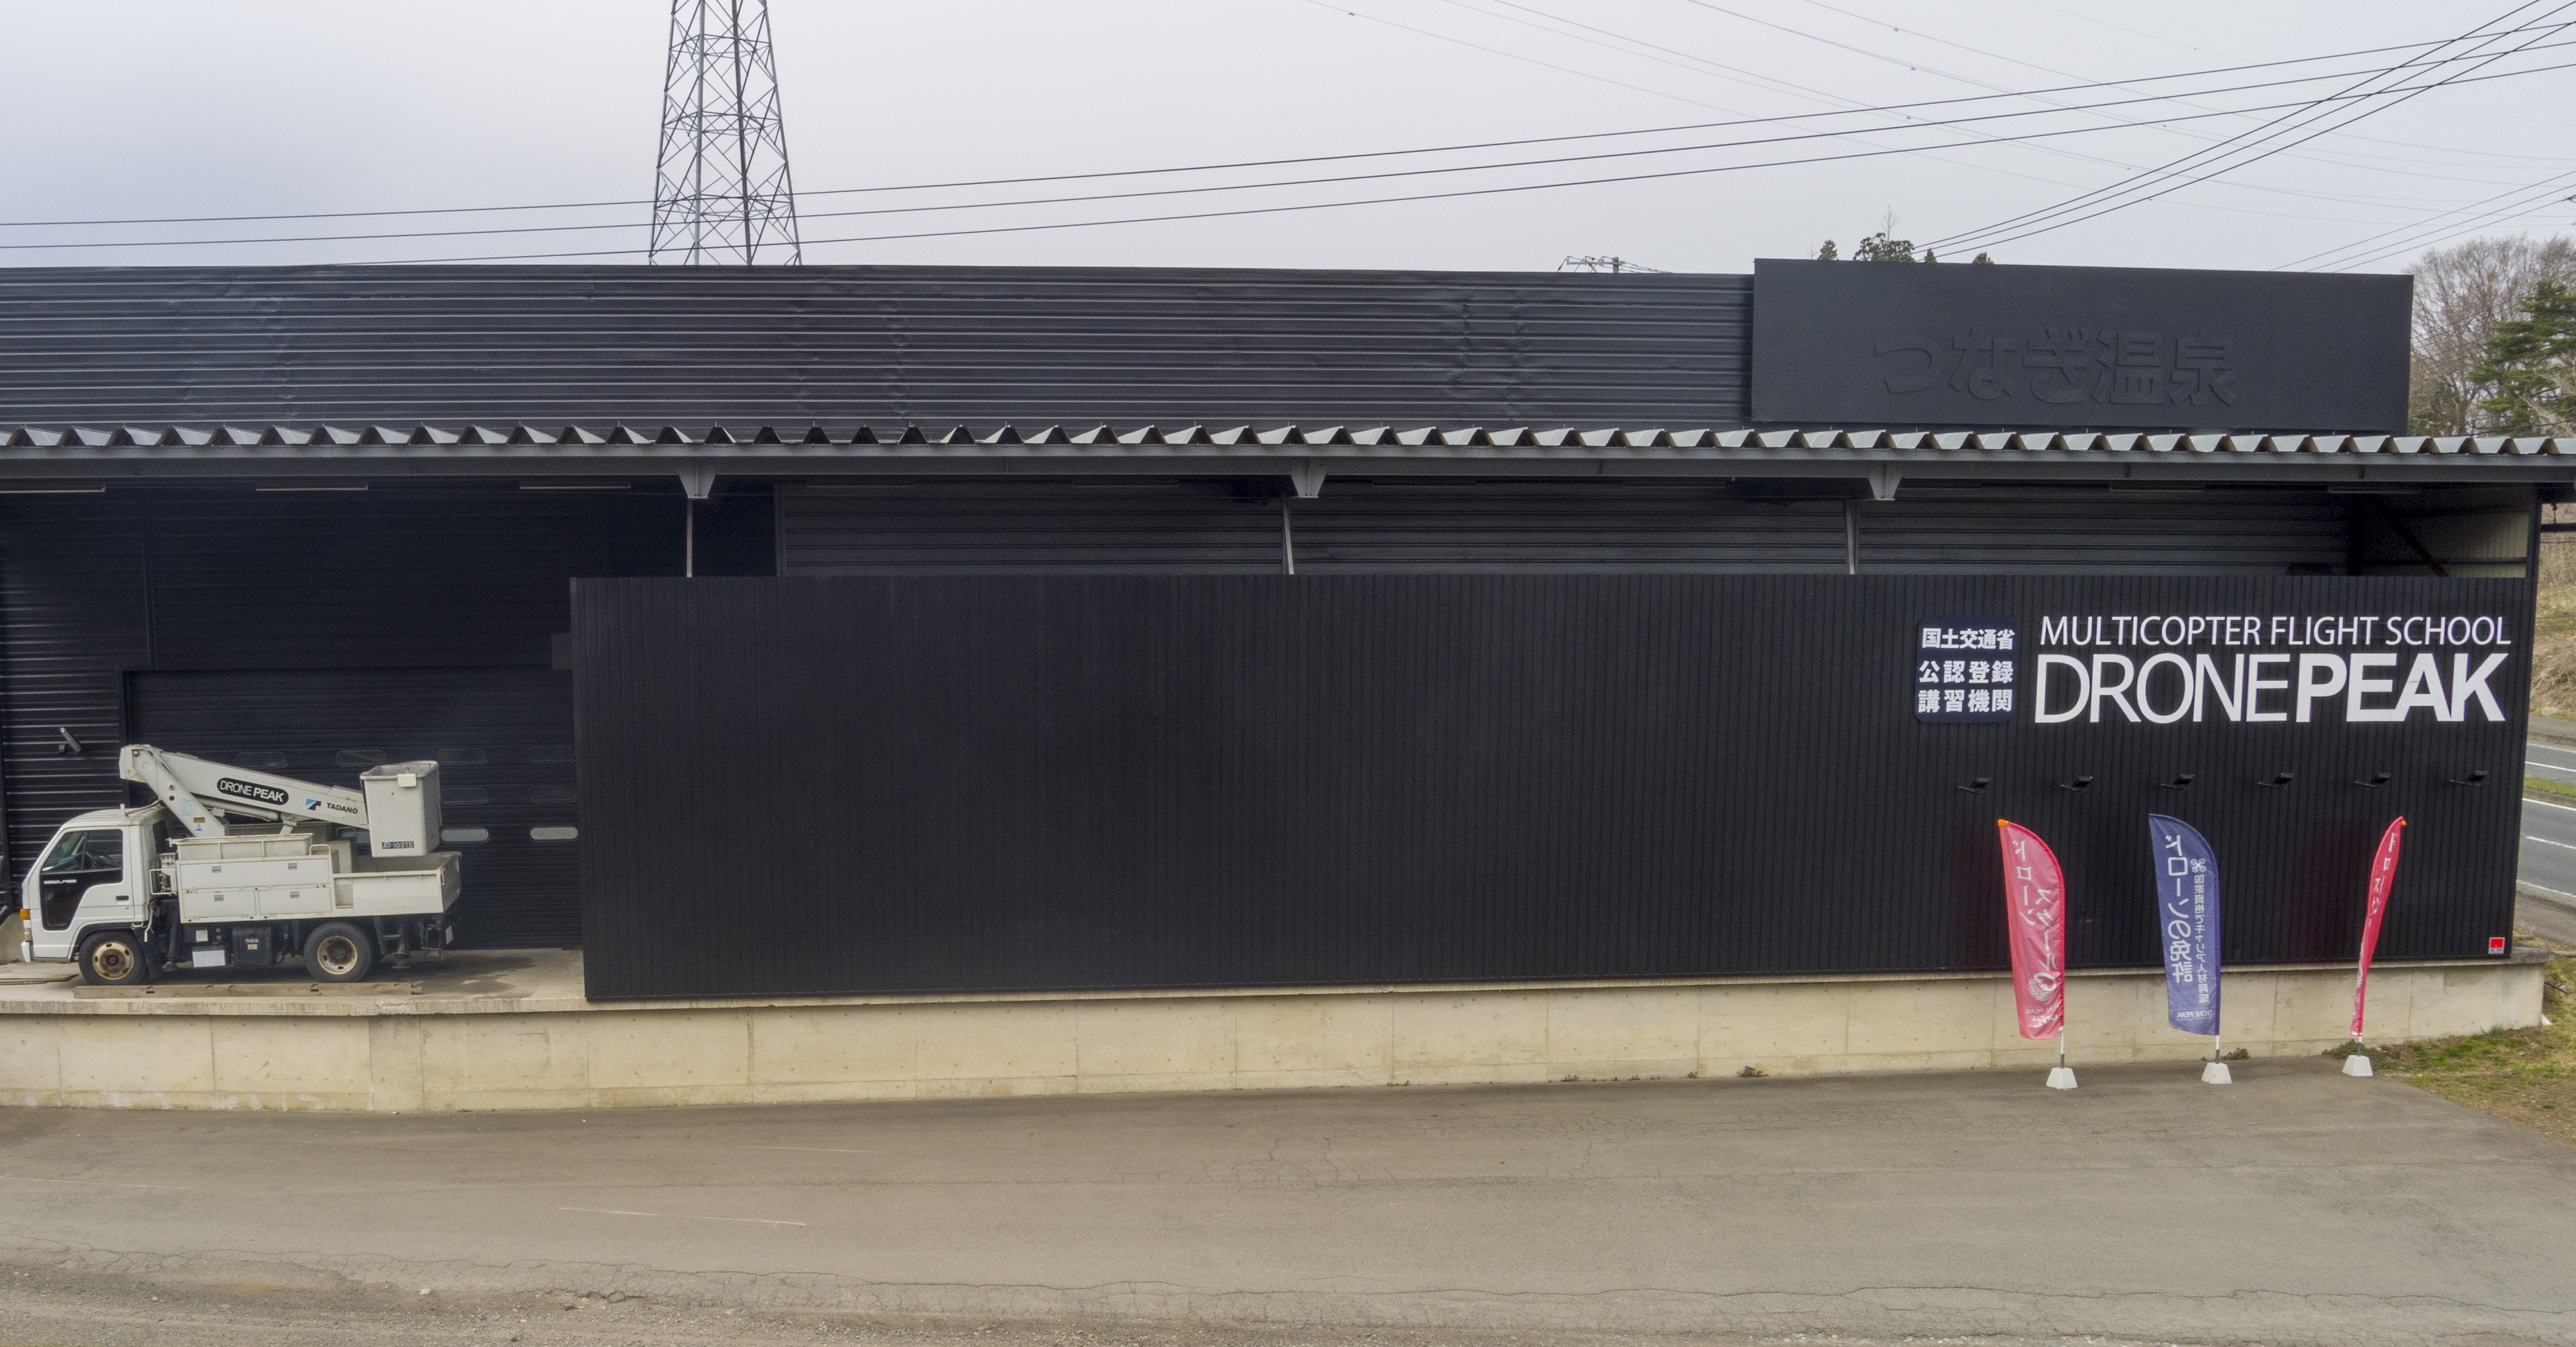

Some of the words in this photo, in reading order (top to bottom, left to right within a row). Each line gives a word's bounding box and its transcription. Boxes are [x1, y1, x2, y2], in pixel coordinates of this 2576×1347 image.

[1873, 327, 2234, 406] つなぎ温泉
[1922, 628, 2015, 650] 国土交通省
[2040, 616, 2261, 645] MULTICOPTER
[2271, 616, 2379, 645] FLIGHT
[2385, 616, 2511, 645] SCHOOL
[1919, 660, 2013, 683] 公認登録
[1918, 689, 2013, 713] 講習機関
[220, 780, 253, 796] DRONE
[253, 787, 285, 803] PEAK
[326, 803, 358, 814] TADANO
